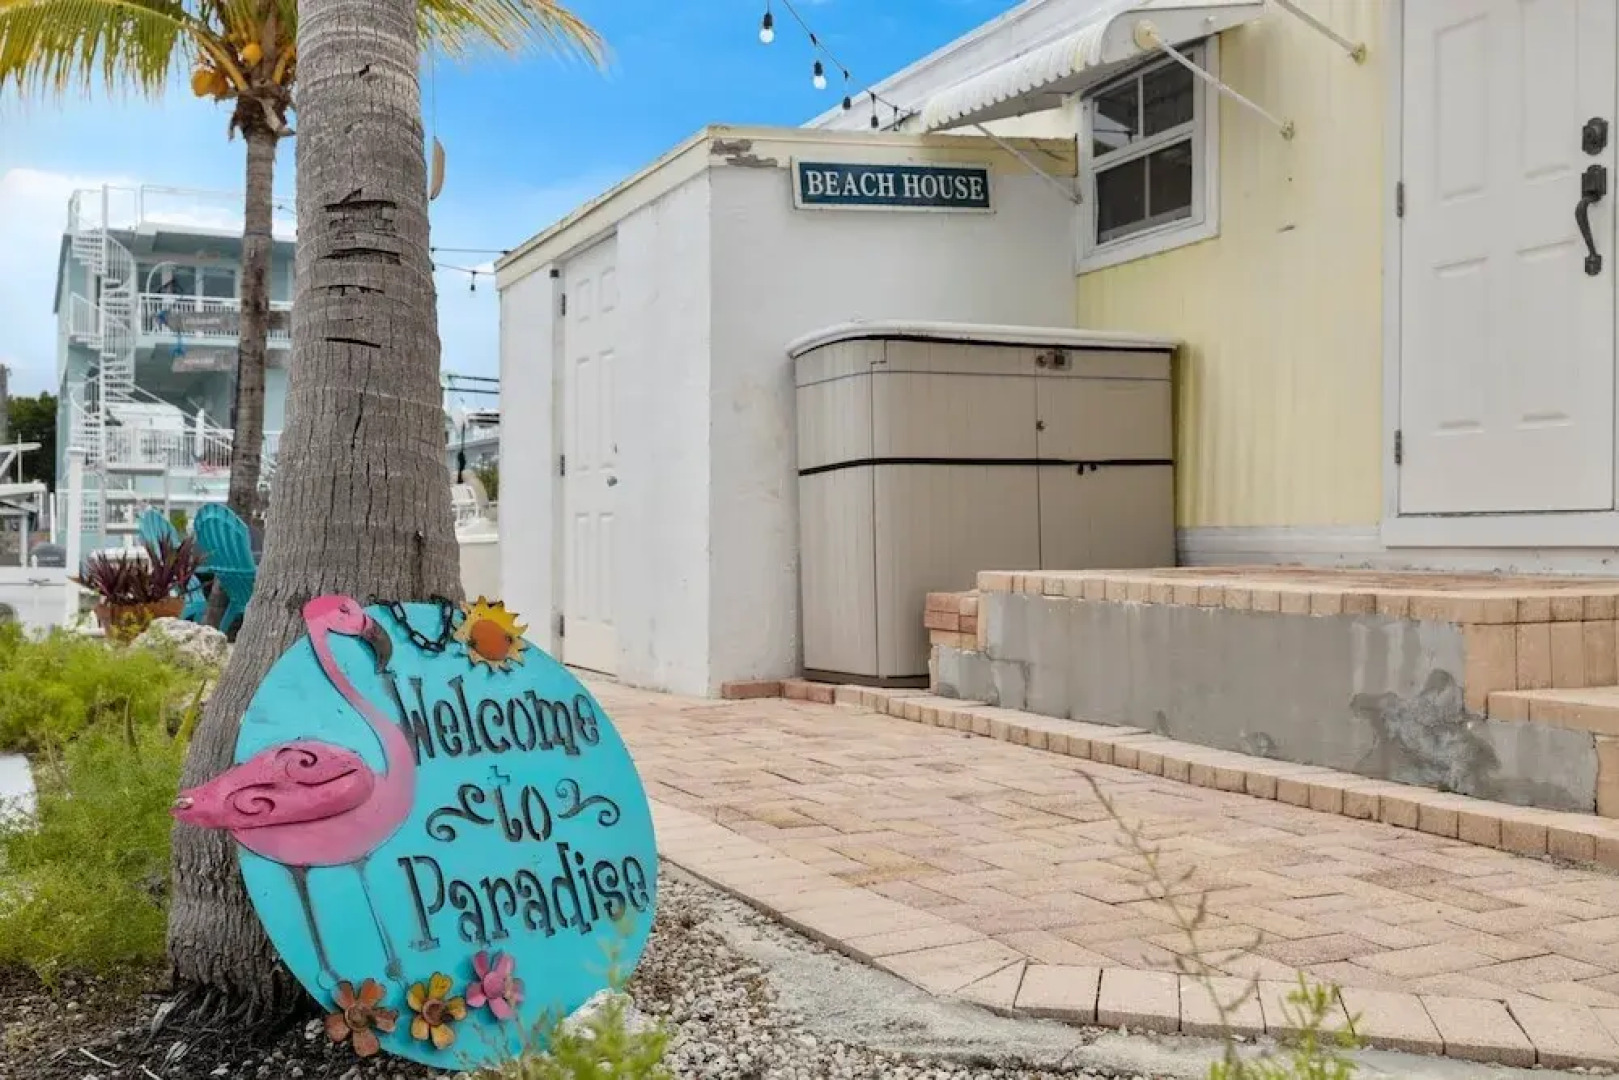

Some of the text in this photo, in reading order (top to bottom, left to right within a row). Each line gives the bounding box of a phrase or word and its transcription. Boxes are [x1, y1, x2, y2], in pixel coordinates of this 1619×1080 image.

[806, 170, 984, 201] BEACH HOUSE
[386, 672, 600, 766] Welcome
[486, 764, 553, 843] to
[397, 841, 650, 952] Paradise
